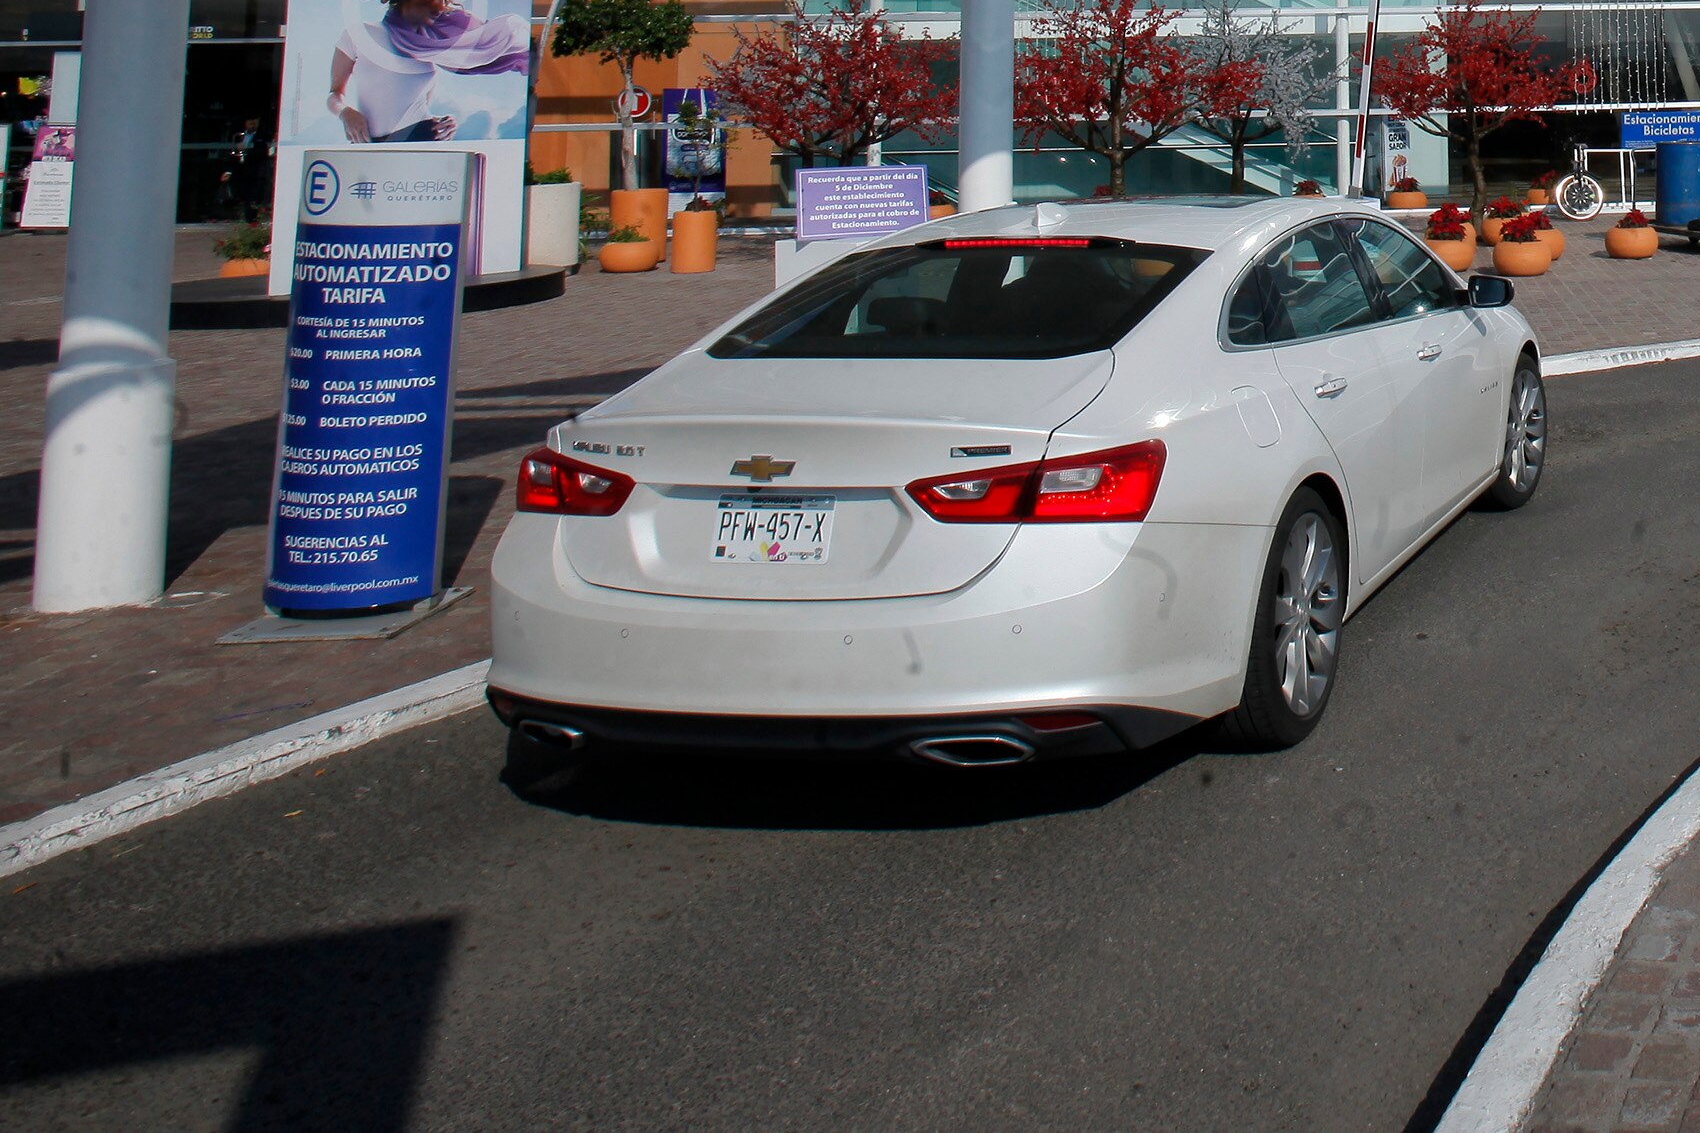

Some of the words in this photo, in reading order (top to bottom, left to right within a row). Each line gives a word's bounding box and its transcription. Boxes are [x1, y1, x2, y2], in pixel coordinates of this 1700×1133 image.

[1643, 124, 1695, 136] Bicicletas
[807, 174, 845, 184] Recuerda
[846, 177, 862, 185] que
[869, 174, 891, 182] partir
[309, 171, 328, 204] E
[824, 194, 841, 202] este
[842, 191, 905, 201] establecimiento
[809, 211, 857, 221] autorizadas
[858, 211, 876, 219] para
[885, 209, 909, 217] cobro
[909, 208, 920, 216] de
[831, 221, 900, 229] Estacionamiento.
[296, 241, 454, 259] ESTACIONAMIENTO
[294, 264, 451, 283] AUTOMATIZADO
[322, 287, 386, 304] TARIFA
[297, 315, 333, 327] CORTESÍA
[335, 316, 350, 327] DE
[352, 317, 366, 327] 15
[367, 316, 425, 327] MINUTOS
[316, 330, 329, 338] AL
[329, 329, 386, 339] INGRESAR
[325, 350, 380, 360] PRIMERA
[383, 347, 422, 358] HORA
[290, 377, 310, 390] $3.00
[323, 380, 355, 391] CADA
[359, 380, 373, 391] 15
[375, 376, 436, 390] MINUTOS
[321, 394, 331, 404] O
[332, 391, 396, 404] FRACCIÓN
[319, 417, 367, 428] BOLETO
[368, 412, 427, 426] PERDIDO
[281, 444, 313, 460] REALICE
[314, 449, 331, 461] SU
[332, 448, 371, 461] PAGO
[374, 446, 392, 459] EN
[396, 443, 423, 457] LOS
[281, 459, 318, 475] CAJEROS
[319, 458, 420, 476] AUTOMATICOS
[287, 490, 336, 505] MINUTOS
[337, 491, 375, 505] PARA
[377, 487, 418, 502] SALIR
[280, 504, 323, 519] DESPUES
[324, 509, 343, 520] DE
[344, 507, 363, 519] SU
[366, 503, 407, 517] PAGO
[718, 511, 827, 543] PFW-457-X
[285, 535, 368, 549] SUGERENCIAS
[369, 534, 389, 546] AL
[314, 549, 379, 563] 215.70.65
